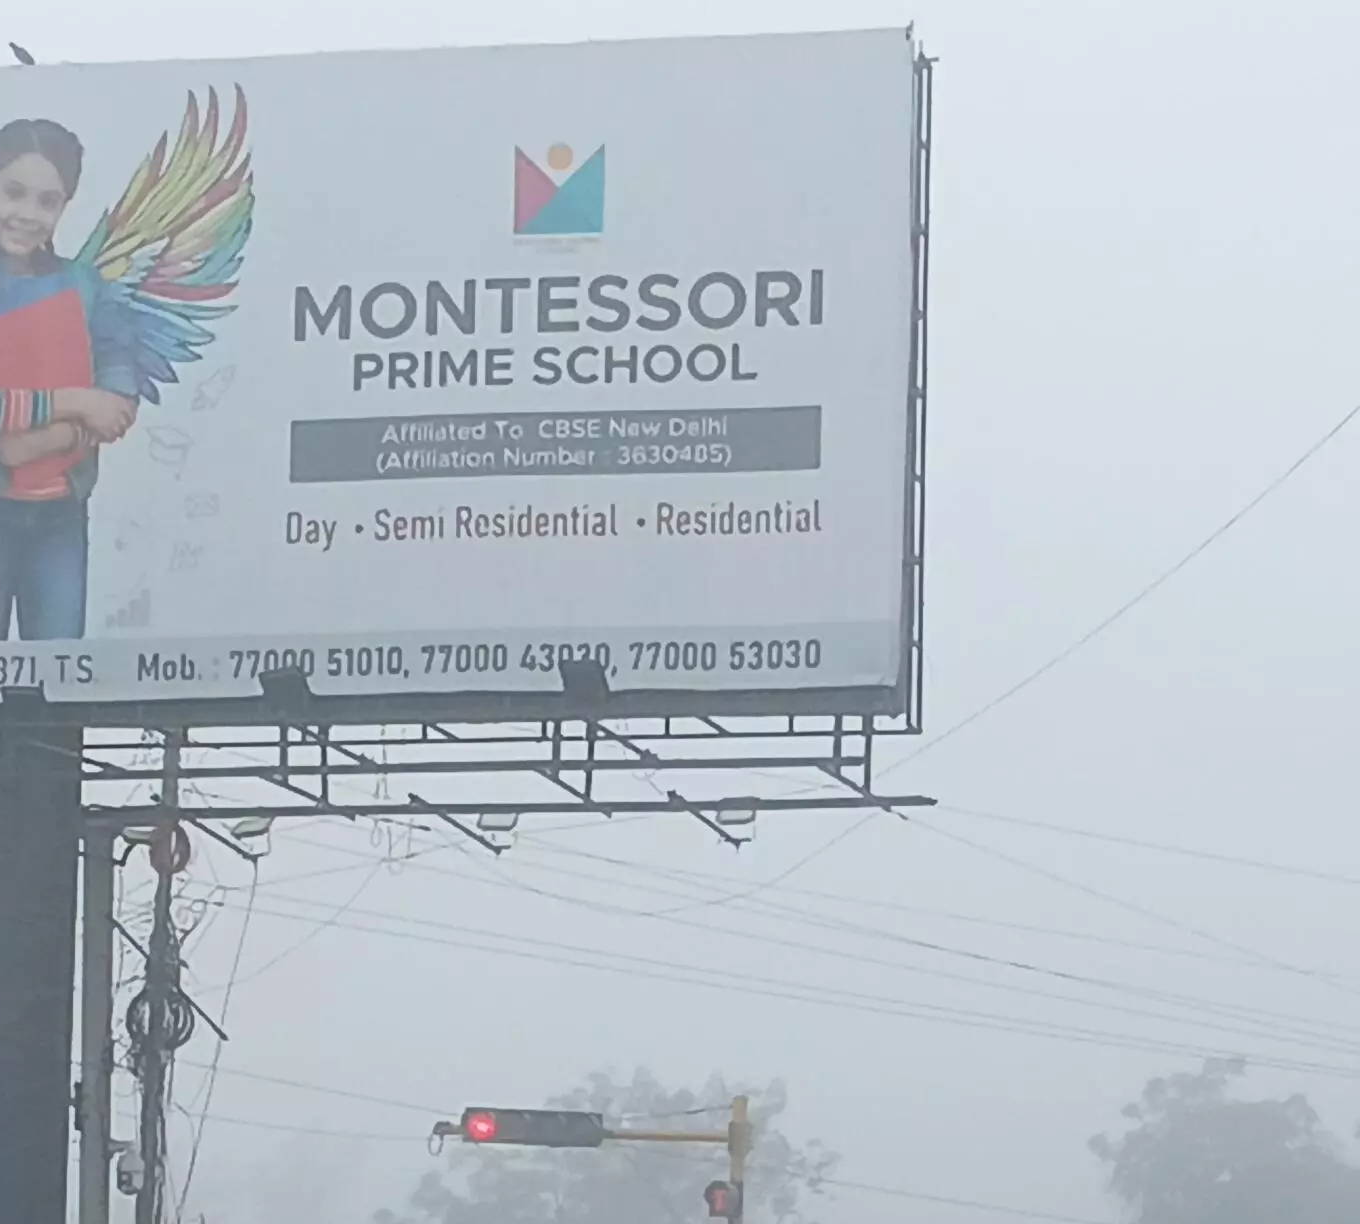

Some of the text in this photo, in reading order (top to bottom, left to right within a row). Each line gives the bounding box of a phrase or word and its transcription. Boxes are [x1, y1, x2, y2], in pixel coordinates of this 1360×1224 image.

[293, 269, 824, 342] MONTESSORI
[352, 342, 758, 391] PRIME SCHOOL
[381, 415, 728, 444] Affiliated To CBSE New Delhi
[503, 447, 596, 469] Number
[286, 499, 822, 551] Day Semi Residential Residential
[327, 645, 410, 679] 51010,
[421, 643, 508, 673] 77000
[629, 641, 717, 671] 77000
[729, 638, 821, 670] 53030
